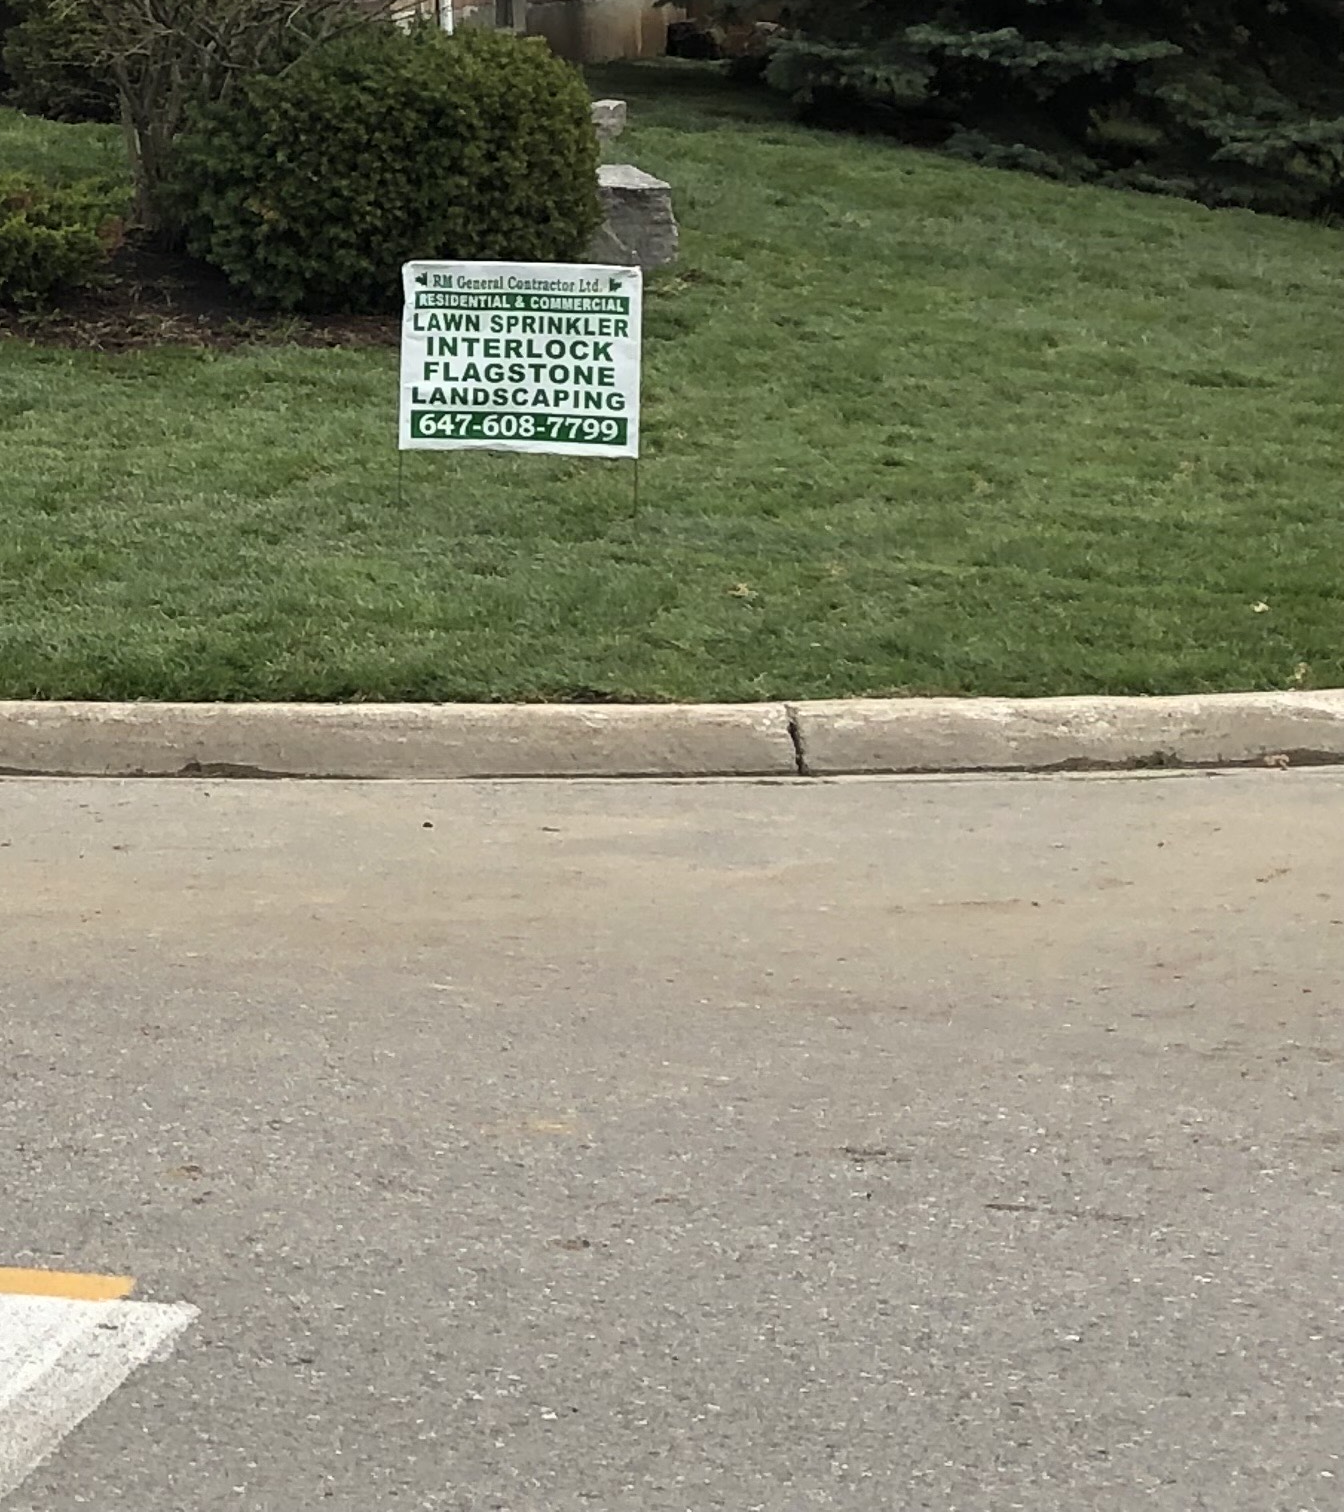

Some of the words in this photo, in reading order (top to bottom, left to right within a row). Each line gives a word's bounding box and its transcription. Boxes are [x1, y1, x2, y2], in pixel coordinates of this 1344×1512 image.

[433, 274, 453, 288] RM
[457, 275, 504, 290] General
[508, 276, 576, 292] Contractor
[579, 278, 603, 293] Ltd.
[419, 293, 511, 308] RESIDENTIAL
[515, 295, 526, 308] &
[530, 296, 625, 313] COMMERCIAL
[413, 313, 480, 332] LAWN
[490, 314, 629, 338] SPRINKLER
[426, 336, 614, 362] INTERLOCK
[423, 361, 615, 387] FLAGSTONE
[411, 386, 626, 411] LANDSCAPING
[418, 414, 619, 442] 647-608-7799
